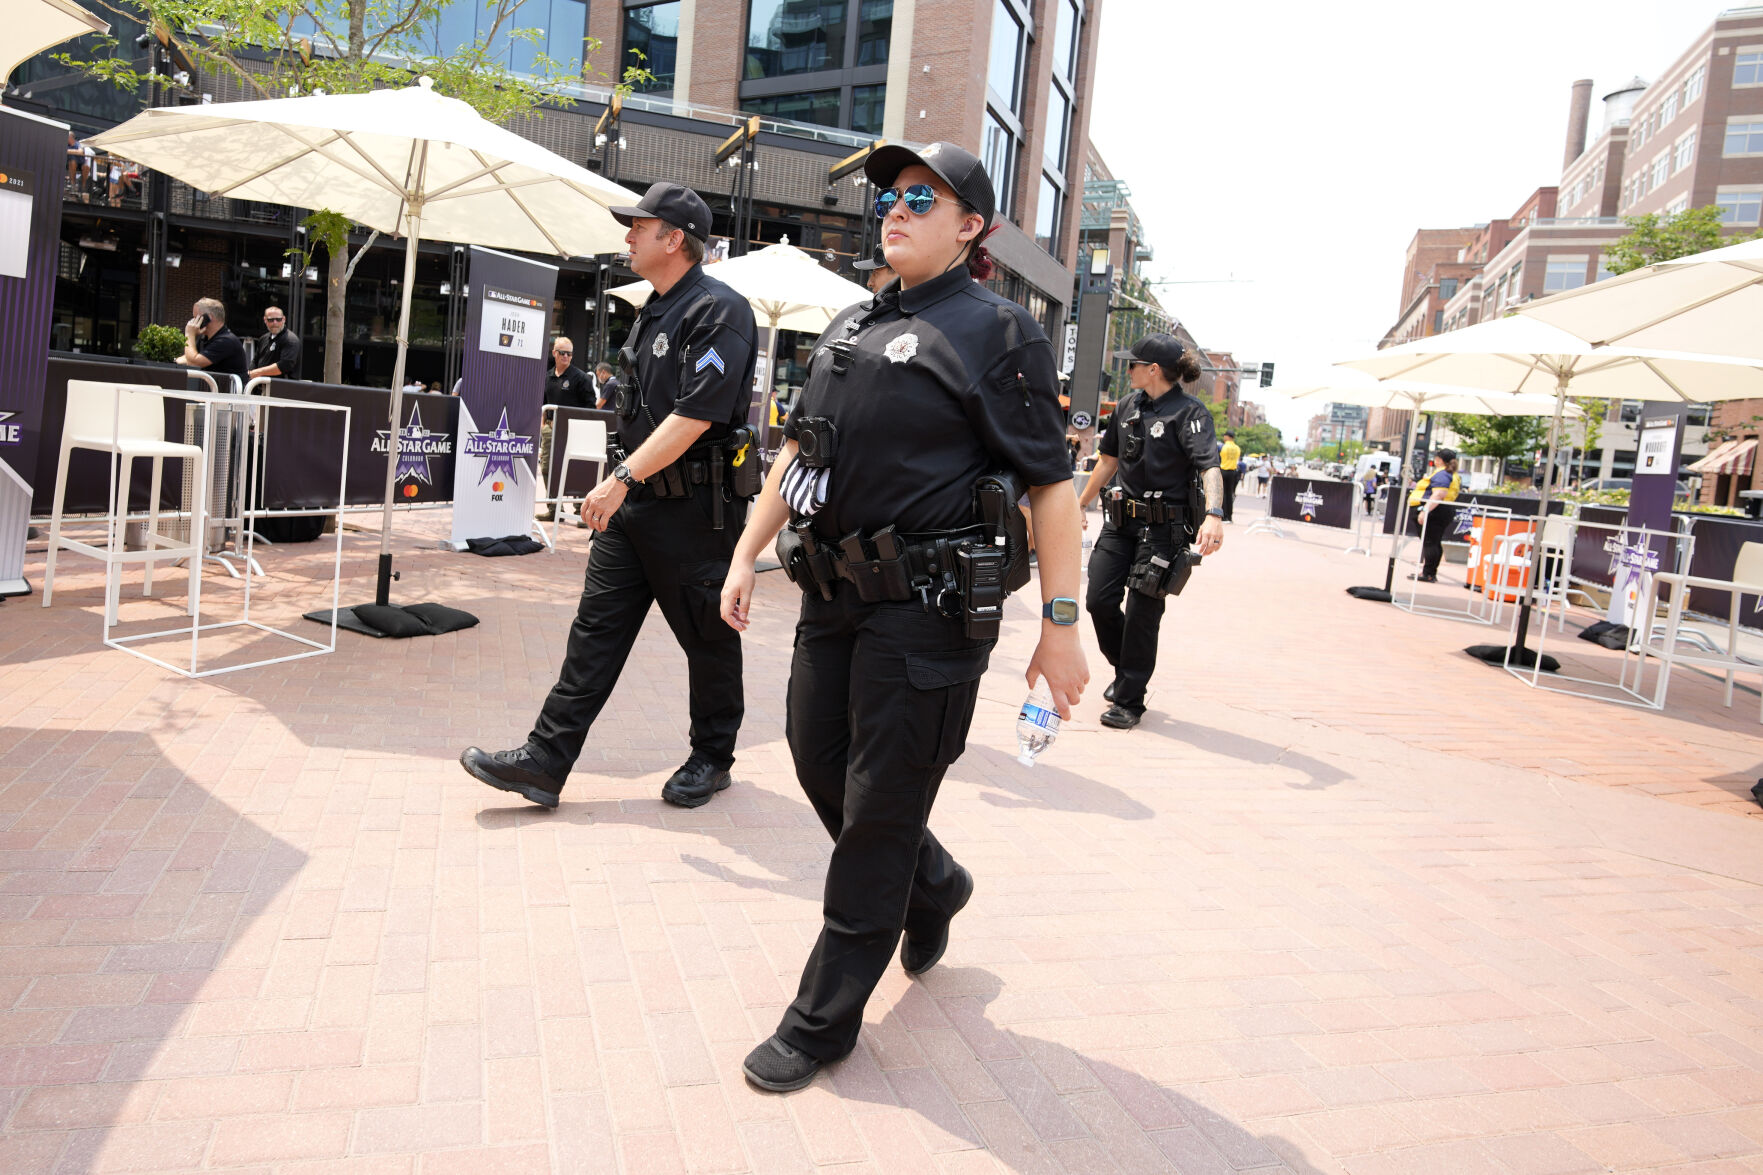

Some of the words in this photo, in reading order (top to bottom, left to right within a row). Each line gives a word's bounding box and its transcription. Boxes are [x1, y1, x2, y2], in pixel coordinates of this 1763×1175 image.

[9, 178, 24, 187] 2021
[501, 317, 526, 334] HADER
[1067, 328, 1076, 363] TOMS
[422, 439, 452, 453] GAME
[508, 441, 534, 454] GAME
[491, 494, 503, 502] FOX
